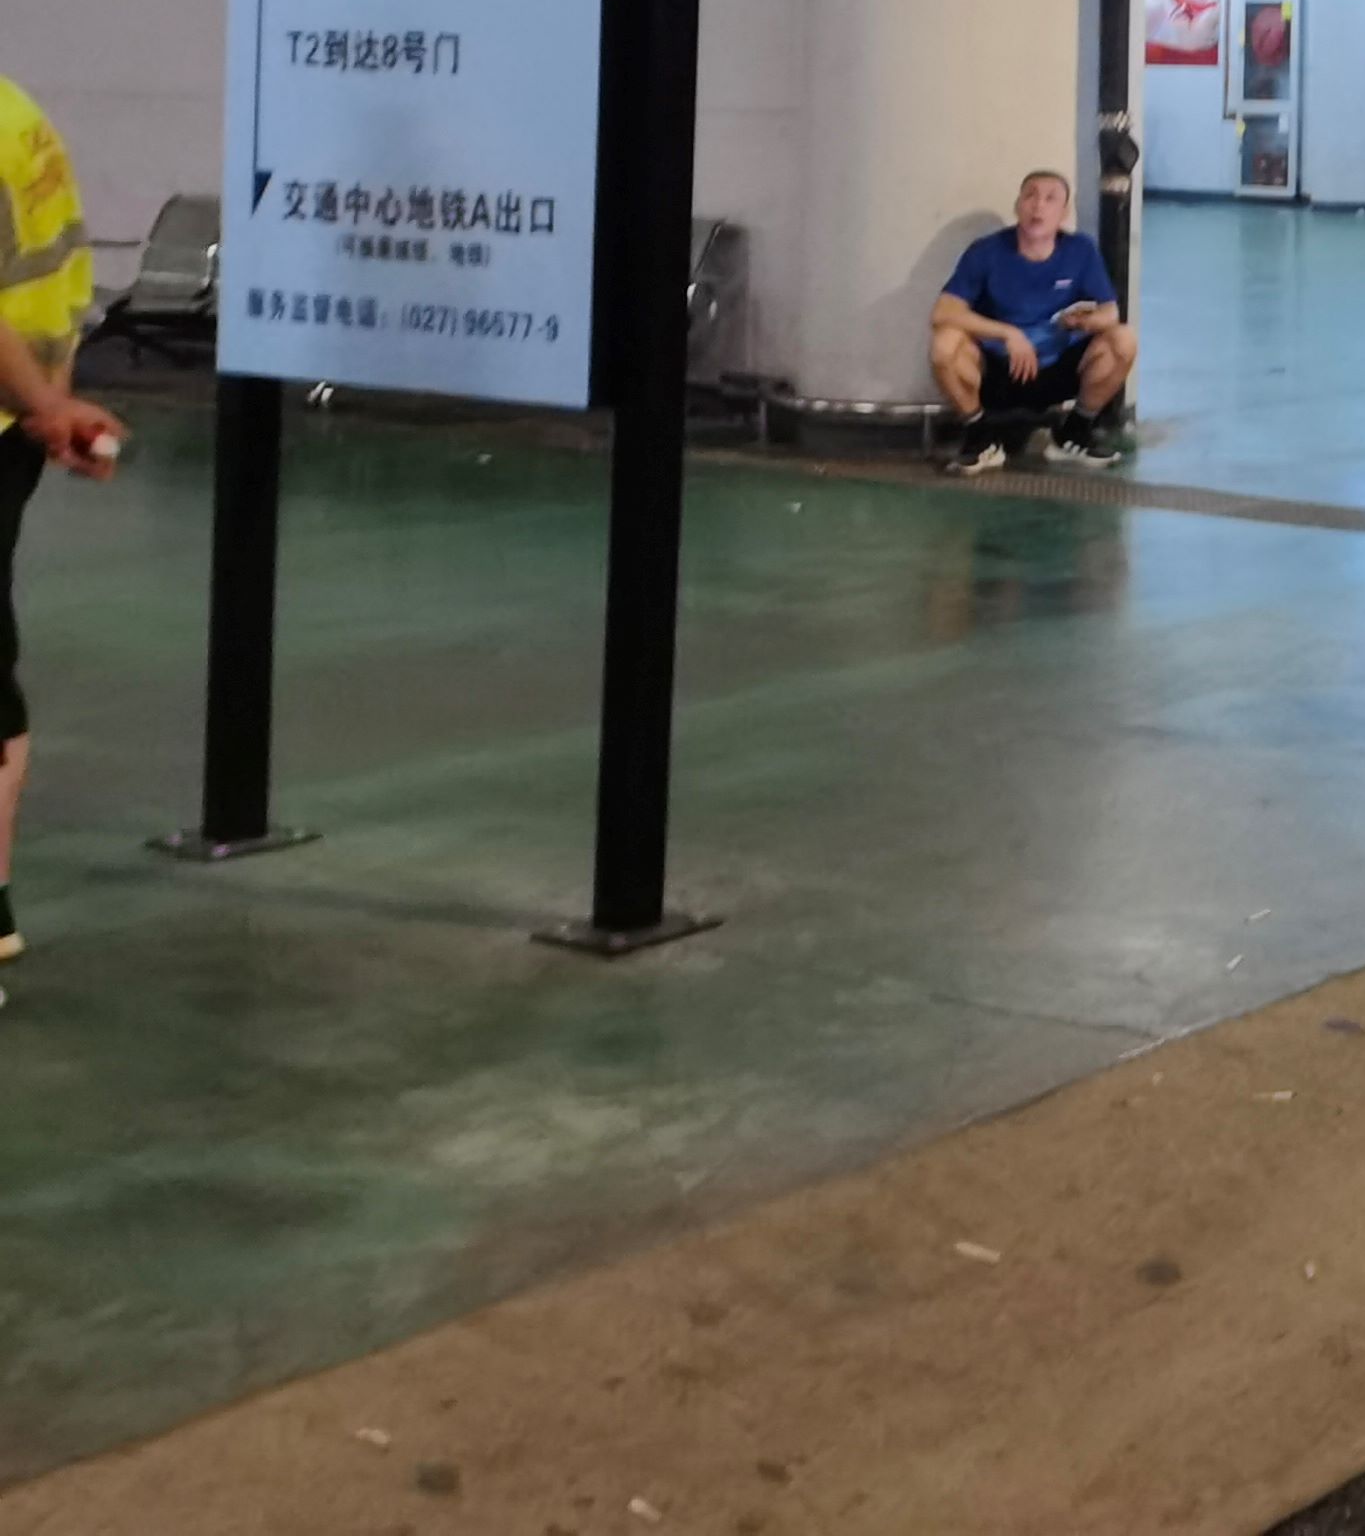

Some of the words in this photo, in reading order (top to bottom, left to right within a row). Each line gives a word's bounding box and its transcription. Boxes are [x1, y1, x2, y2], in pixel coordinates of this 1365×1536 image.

[287, 30, 460, 75] T2到达8号门
[283, 181, 555, 233] 交通中心地铁A出口
